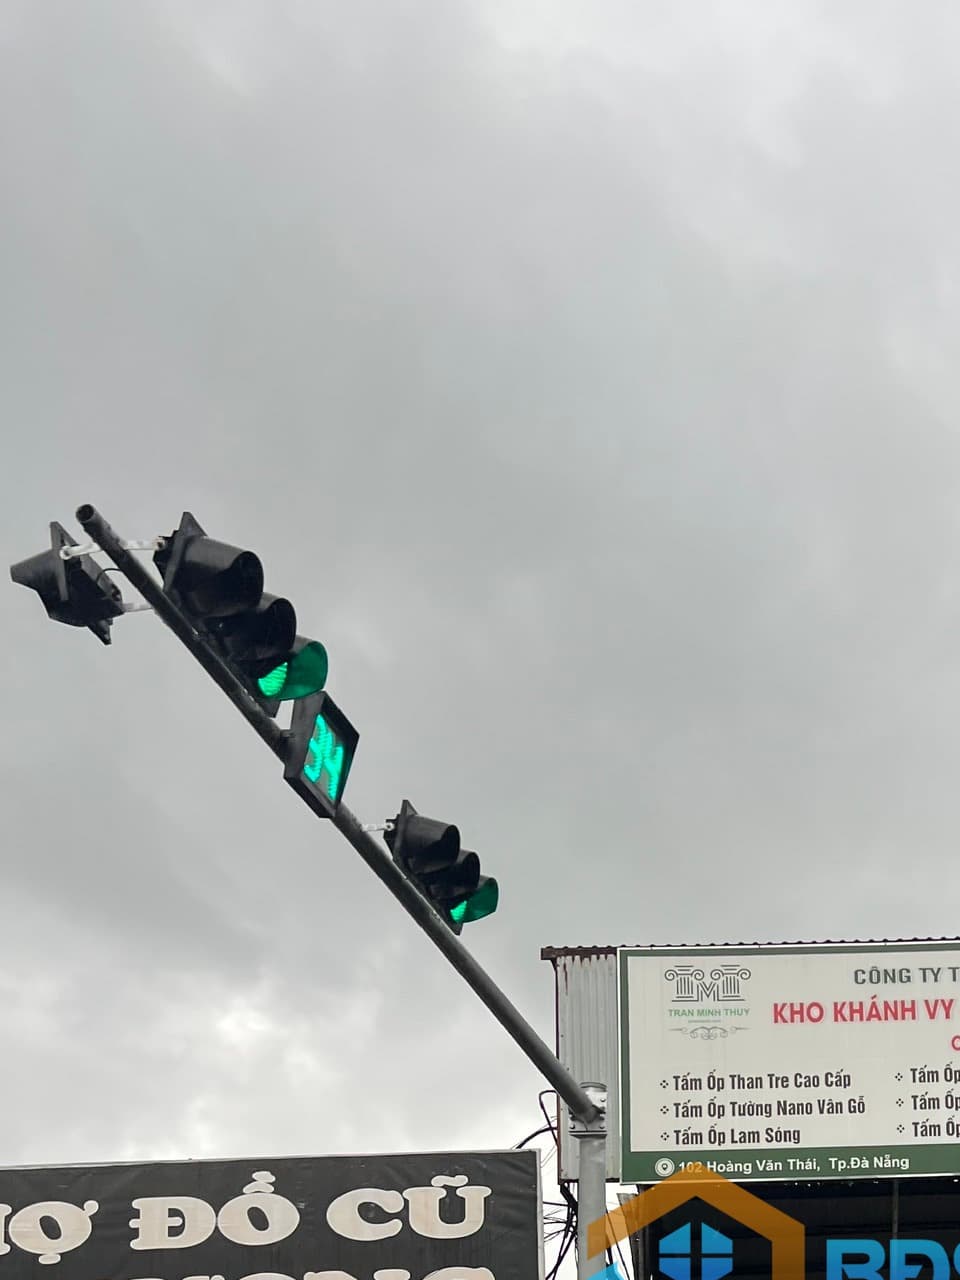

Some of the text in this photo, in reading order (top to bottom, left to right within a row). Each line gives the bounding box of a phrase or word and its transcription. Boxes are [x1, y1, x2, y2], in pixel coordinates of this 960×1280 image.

[854, 965, 912, 985] CÔNG
[919, 967, 942, 983] TY
[668, 1009, 695, 1017] TRAN
[697, 1008, 721, 1017] MINH
[773, 1000, 824, 1024] KHO
[833, 994, 917, 1022] KHÁNH
[925, 999, 954, 1019] VY
[673, 1069, 851, 1092] Tấm Ốp Than Tre Cao Cấp
[910, 1066, 939, 1084] Tấm
[673, 1095, 866, 1119] Tấm Ốp Tường Nano Vân Gỗ
[911, 1092, 940, 1110] Tấm
[673, 1123, 801, 1146] Tấm Ốp Lam Sóng
[912, 1118, 941, 1137] Tấm
[707, 1159, 753, 1176] Hoàng
[755, 1157, 783, 1171] Văn
[787, 1156, 820, 1173] Thái,
[829, 1155, 870, 1172] Tp.Đà
[873, 1154, 909, 1173] Nẵng
[129, 1170, 300, 1250] ĐỒ
[326, 1174, 492, 1242] CŨ
